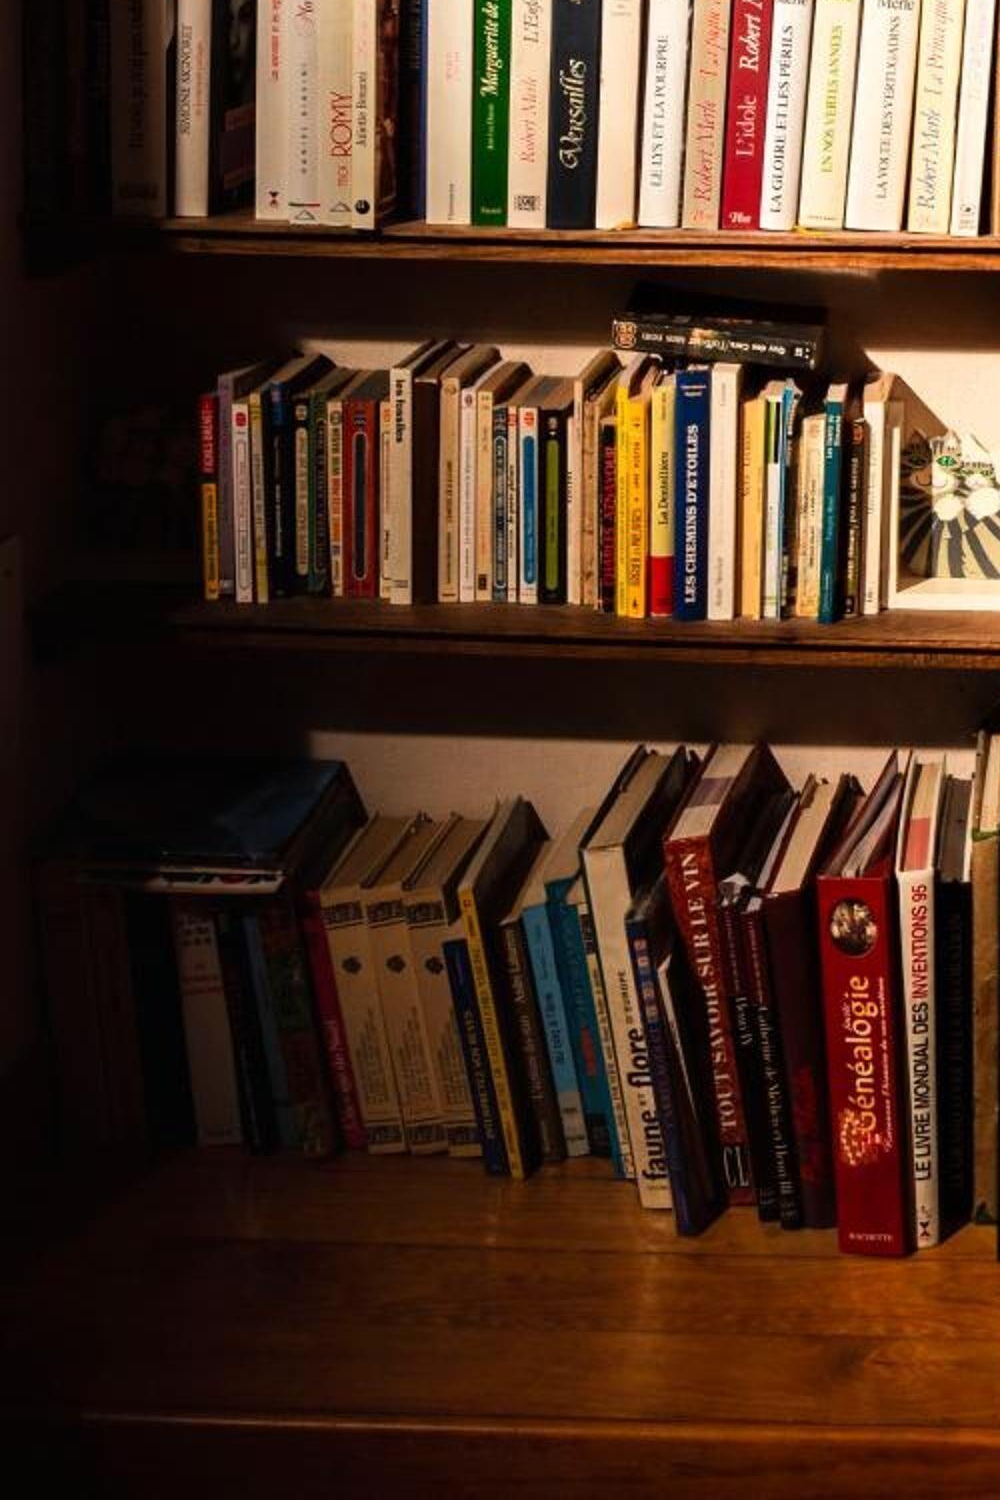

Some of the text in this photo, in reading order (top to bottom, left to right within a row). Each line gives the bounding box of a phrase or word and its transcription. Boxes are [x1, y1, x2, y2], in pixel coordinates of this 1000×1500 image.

[482, 3, 498, 18] de
[738, 15, 761, 72] Robert
[180, 24, 192, 135] SIMONE SIGNORET
[480, 19, 503, 97] Marguerite
[330, 91, 353, 156] ROMY
[519, 76, 537, 164] Robert Merle
[559, 58, 586, 169] Versailles
[649, 35, 669, 187] LE LYS ET LA POURPRE
[694, 100, 717, 201] Robert Merle
[735, 95, 757, 156] L'idole
[770, 81, 790, 213] LA GLOIRE ET LES
[821, 80, 838, 173] EN NOS VERTES
[876, 15, 900, 199] LA VOLTE DES VERTUGADINS
[917, 109, 940, 210] Robert Merle
[396, 379, 406, 397] les
[729, 340, 786, 355] Guy des Cars
[658, 511, 668, 525] La
[685, 506, 698, 573] CHEMINS
[685, 576, 696, 603] LES
[679, 851, 738, 1133] TOUT SAVOIR SUR LE VIN
[911, 884, 931, 1181] LE LIVRE MONDIAL DES INVENTIONS 95
[618, 970, 668, 1180] faune flore D'EUROPE
[844, 975, 878, 1133] Généalogie
